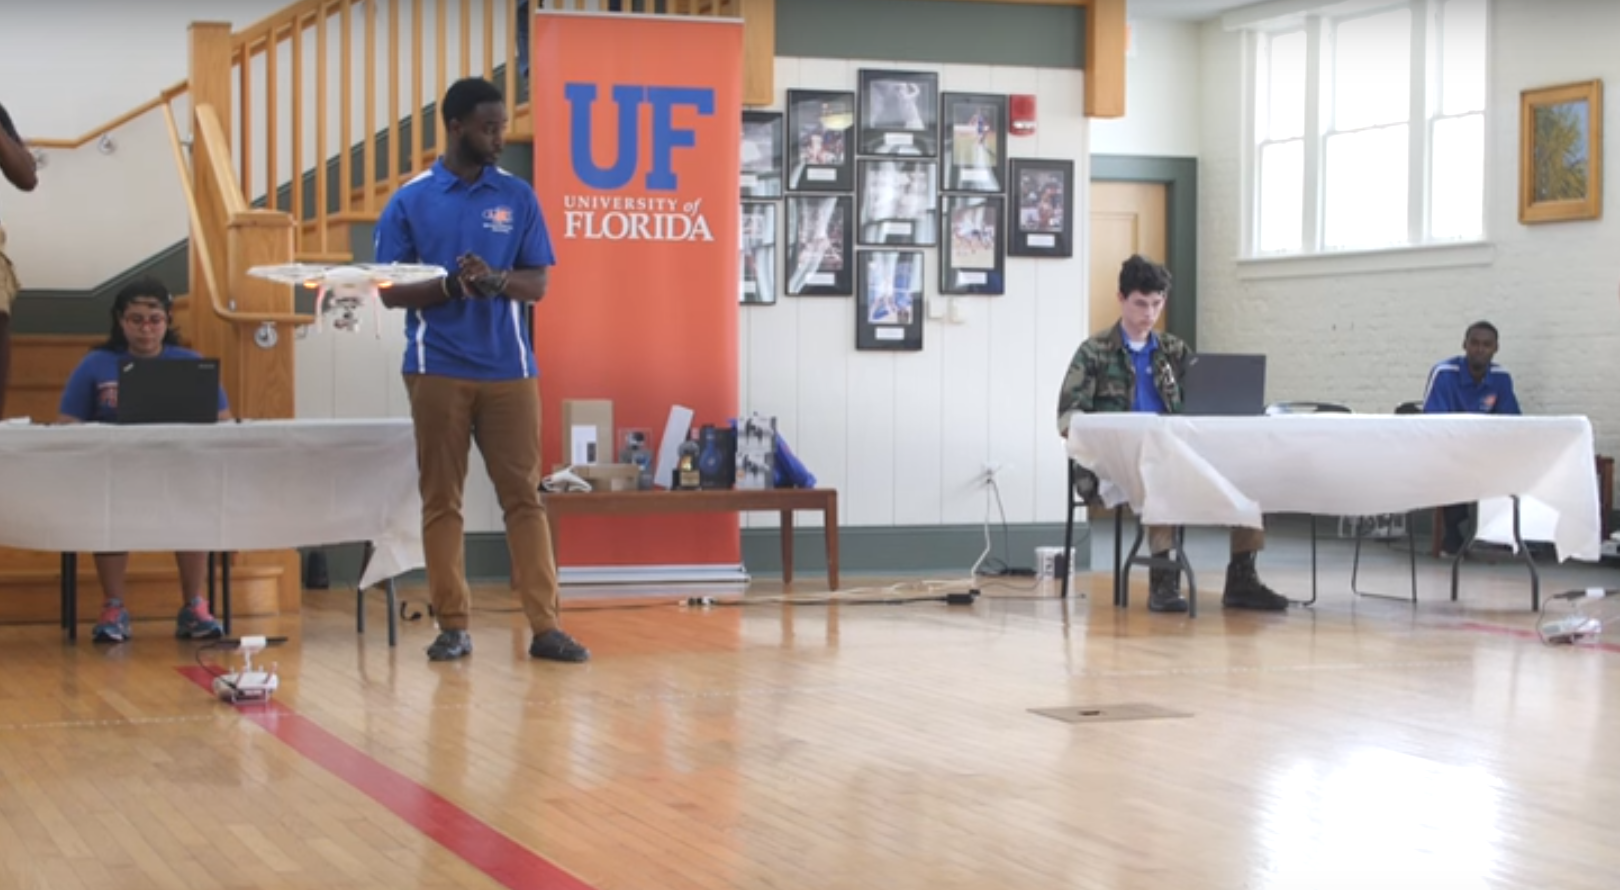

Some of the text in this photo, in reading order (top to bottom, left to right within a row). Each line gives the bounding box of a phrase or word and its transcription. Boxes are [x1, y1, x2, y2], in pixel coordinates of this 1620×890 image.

[564, 82, 715, 190] UF
[564, 195, 703, 216] UNIVERSITY of
[564, 210, 714, 242] FLORIDA
